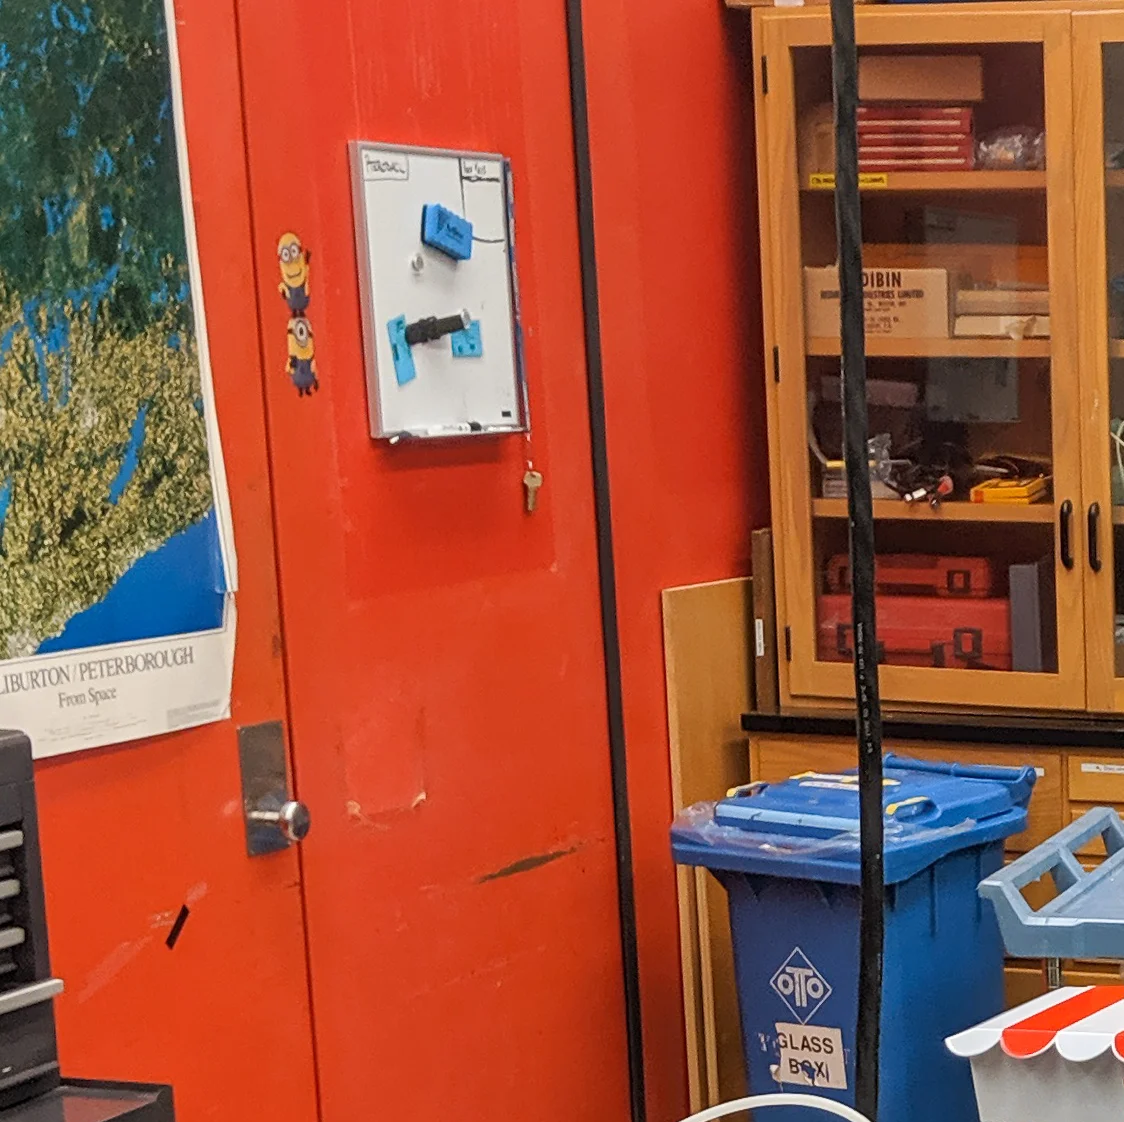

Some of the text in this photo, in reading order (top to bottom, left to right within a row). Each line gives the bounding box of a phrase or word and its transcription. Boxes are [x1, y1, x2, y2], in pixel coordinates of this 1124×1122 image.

[58, 686, 117, 708] From Space
[777, 967, 824, 1008] OTTO
[777, 1032, 834, 1055] GLASS
